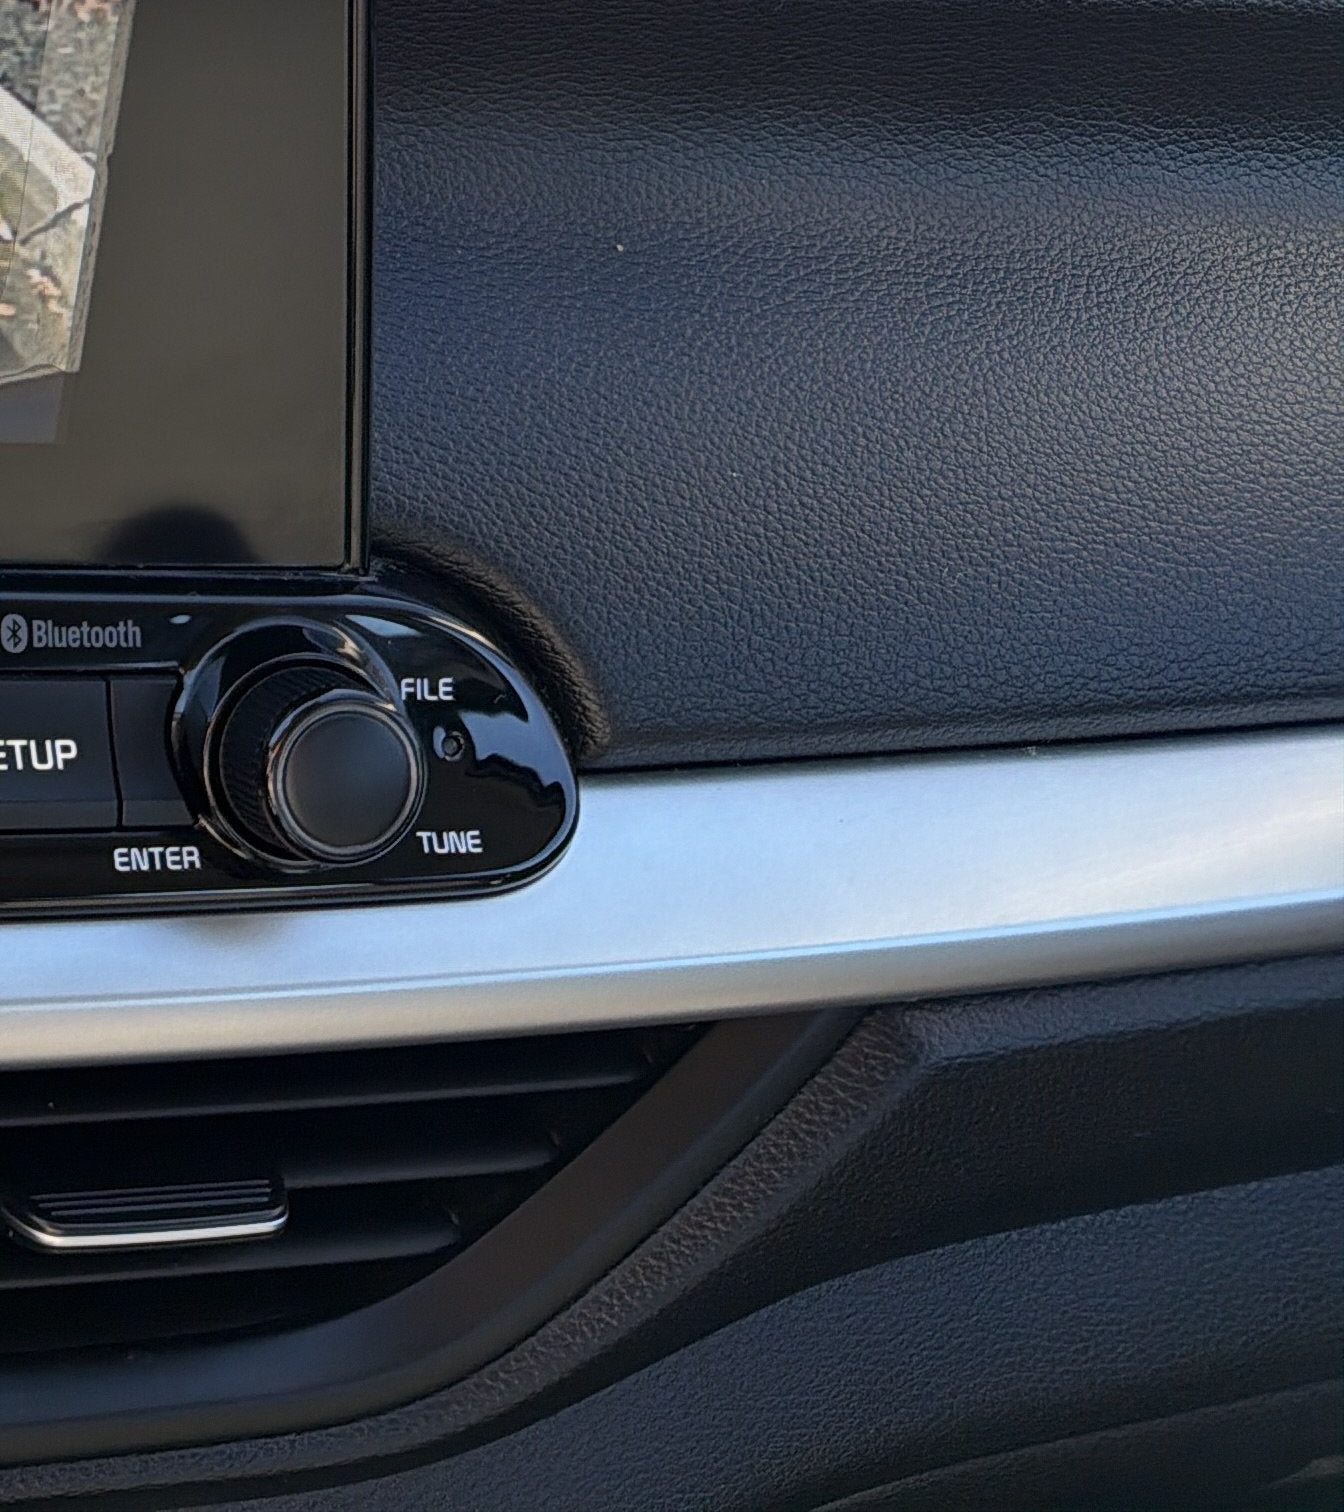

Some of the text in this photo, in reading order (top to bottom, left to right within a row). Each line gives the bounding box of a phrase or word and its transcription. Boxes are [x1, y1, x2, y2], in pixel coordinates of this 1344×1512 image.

[32, 619, 142, 649] Bluetooth
[400, 677, 453, 701] FILE
[416, 829, 483, 854] TUNE
[113, 846, 201, 872] ENTER
